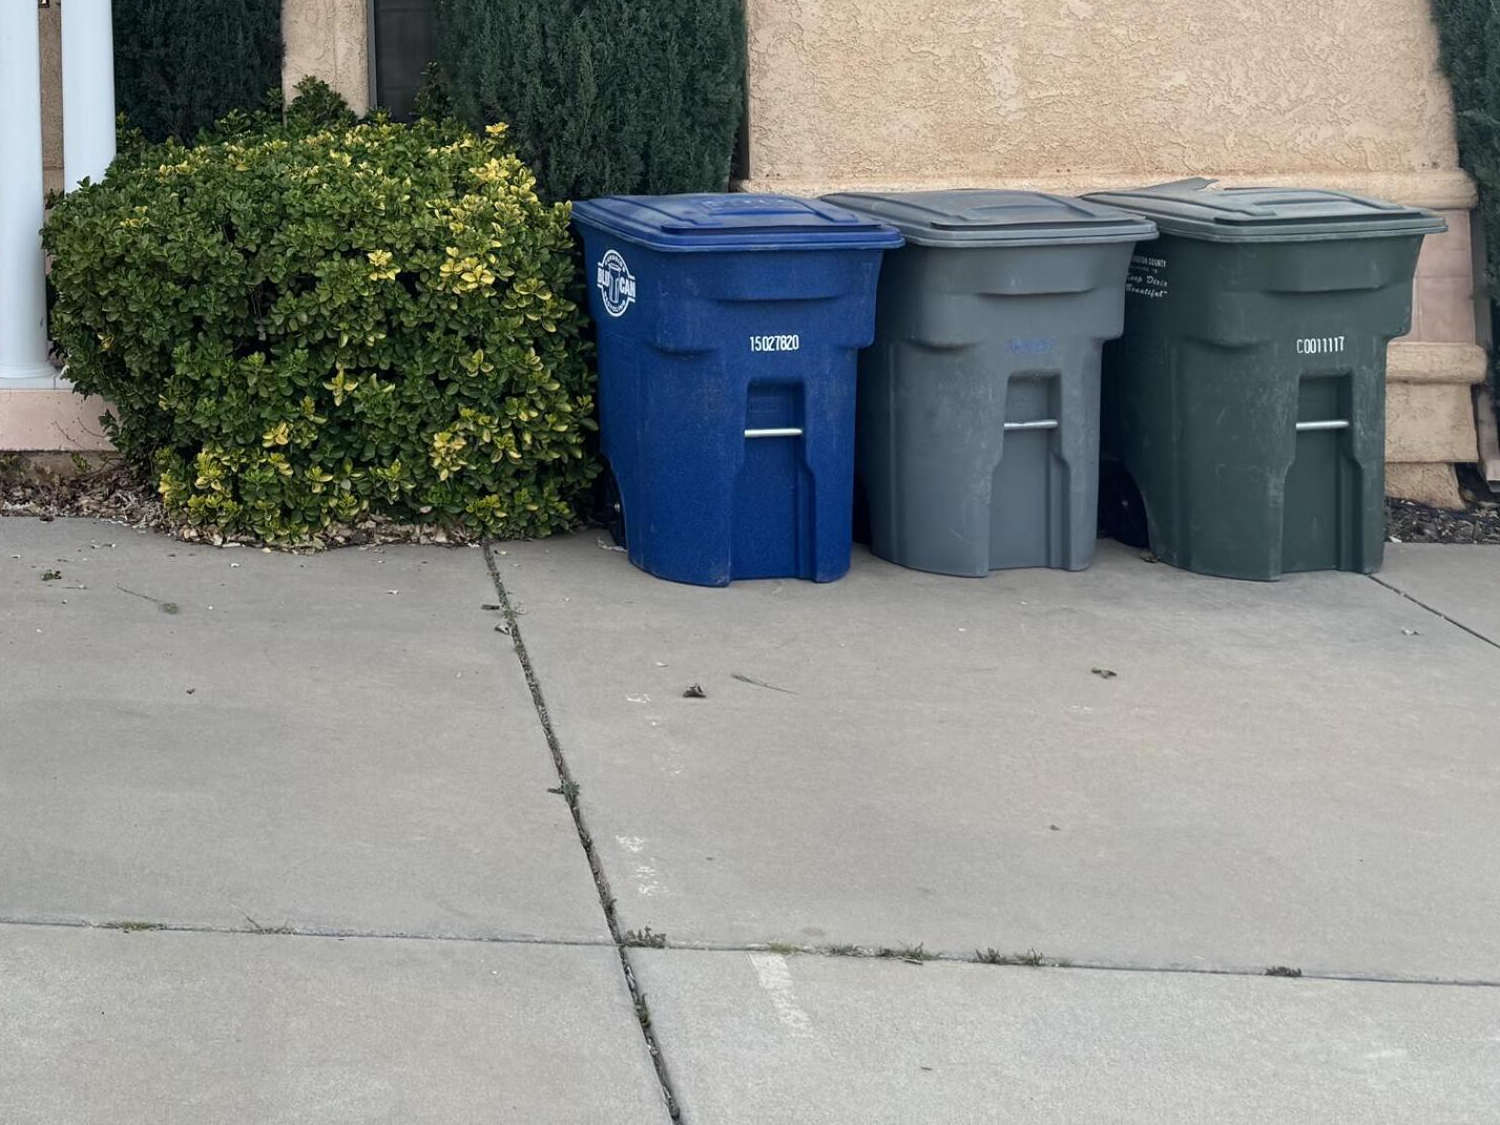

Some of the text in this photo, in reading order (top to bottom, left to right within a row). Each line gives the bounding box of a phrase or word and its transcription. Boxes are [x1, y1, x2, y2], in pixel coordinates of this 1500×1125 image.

[619, 276, 636, 298] CAN
[749, 334, 800, 352] 15027820
[1296, 335, 1345, 354] C0011117
